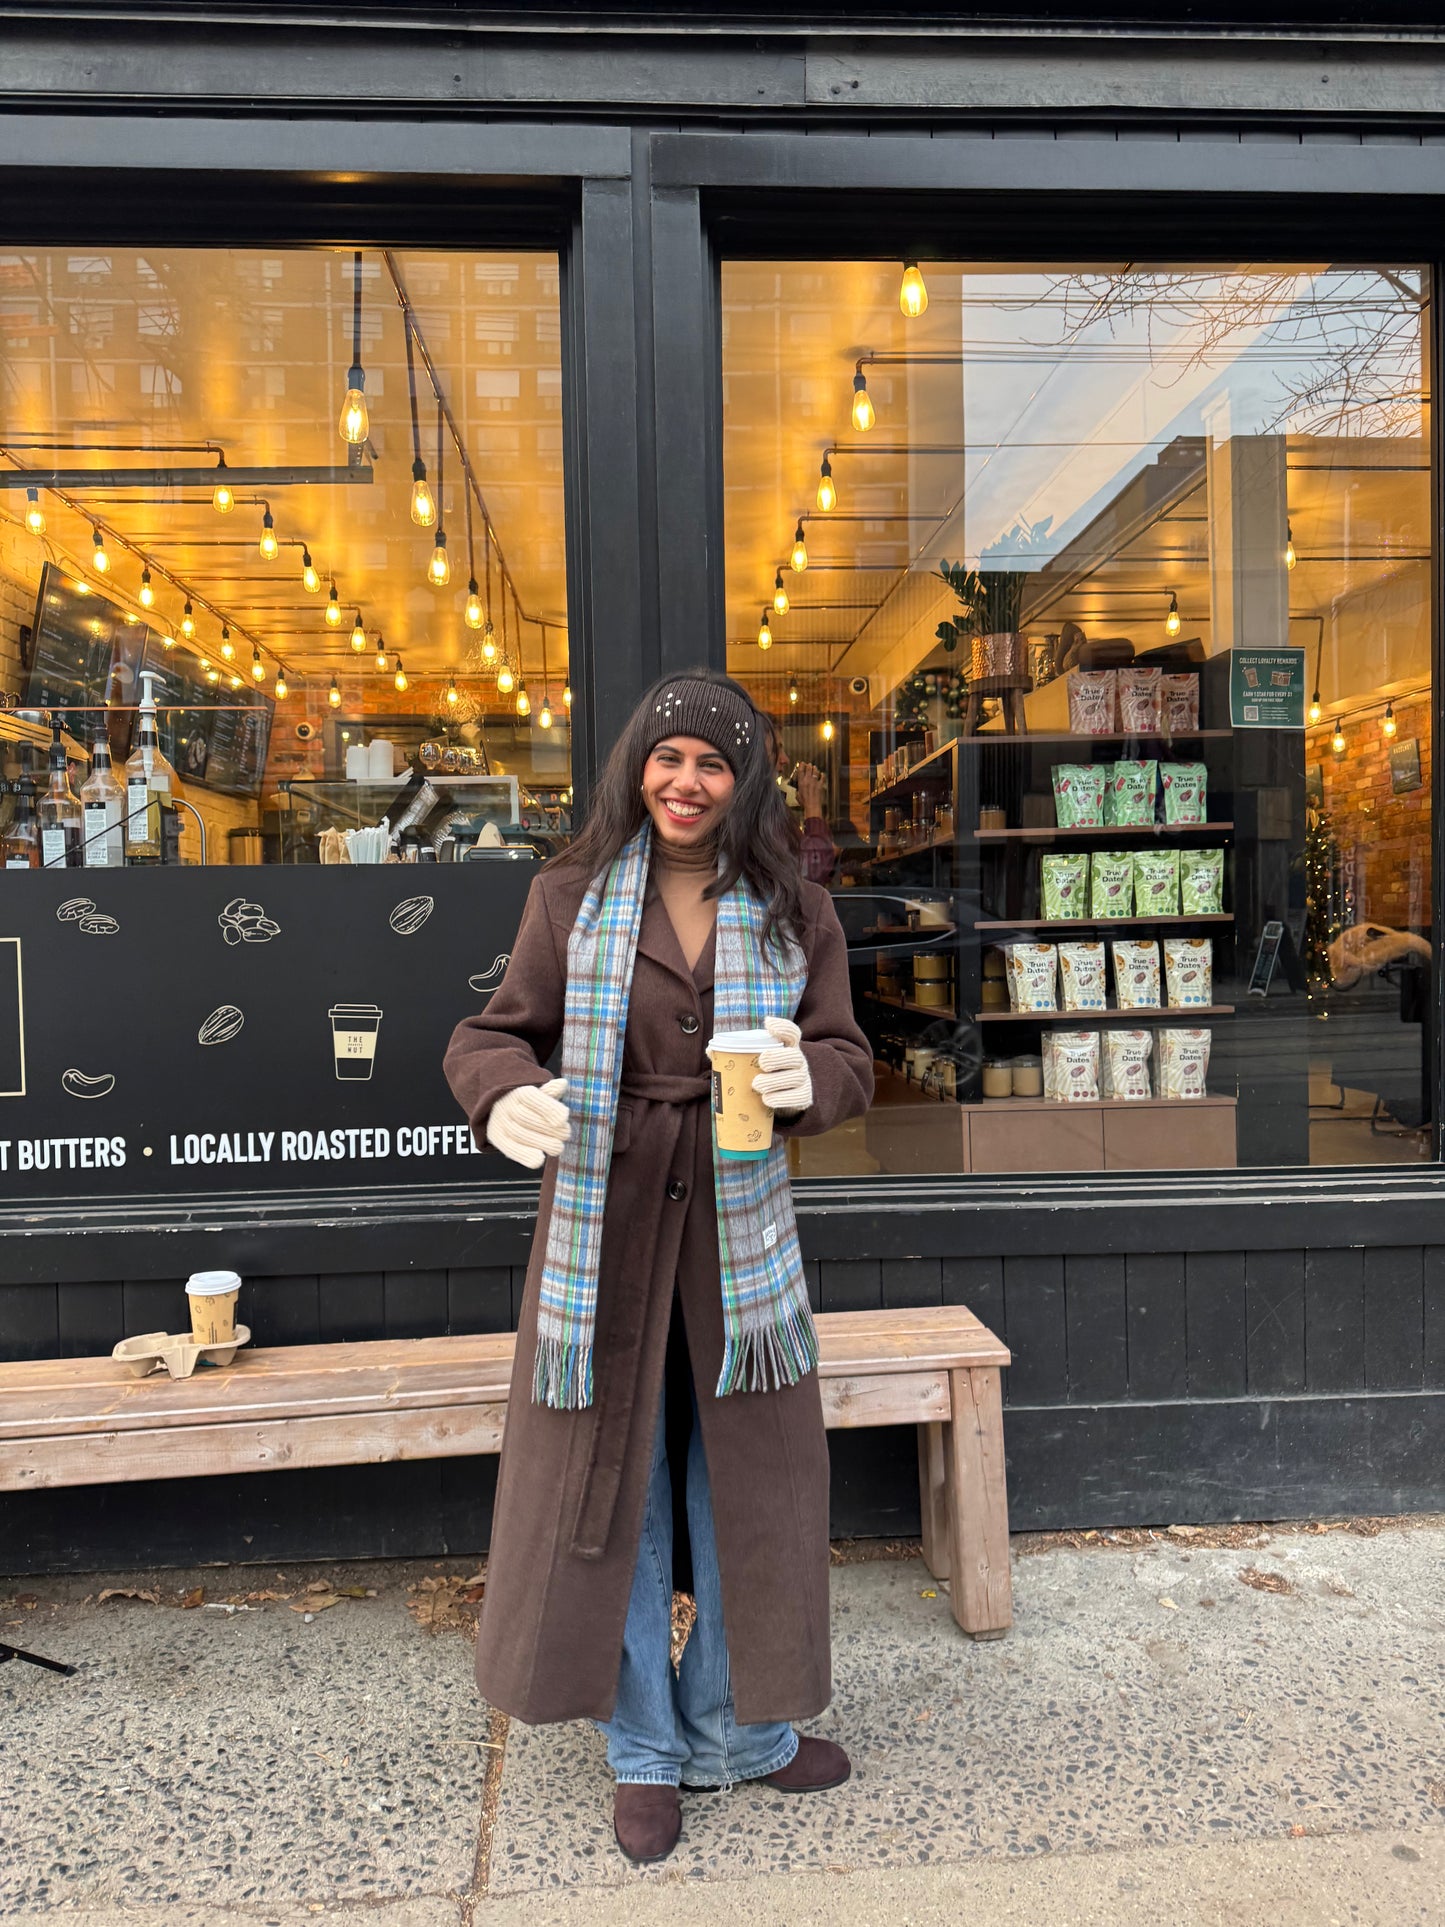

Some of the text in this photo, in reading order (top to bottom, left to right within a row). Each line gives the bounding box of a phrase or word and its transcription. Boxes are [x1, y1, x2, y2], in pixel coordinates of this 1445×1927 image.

[18, 1136, 126, 1171] BUTTERS
[170, 1131, 275, 1165] LOCALLY
[281, 1128, 390, 1161] ROASTED
